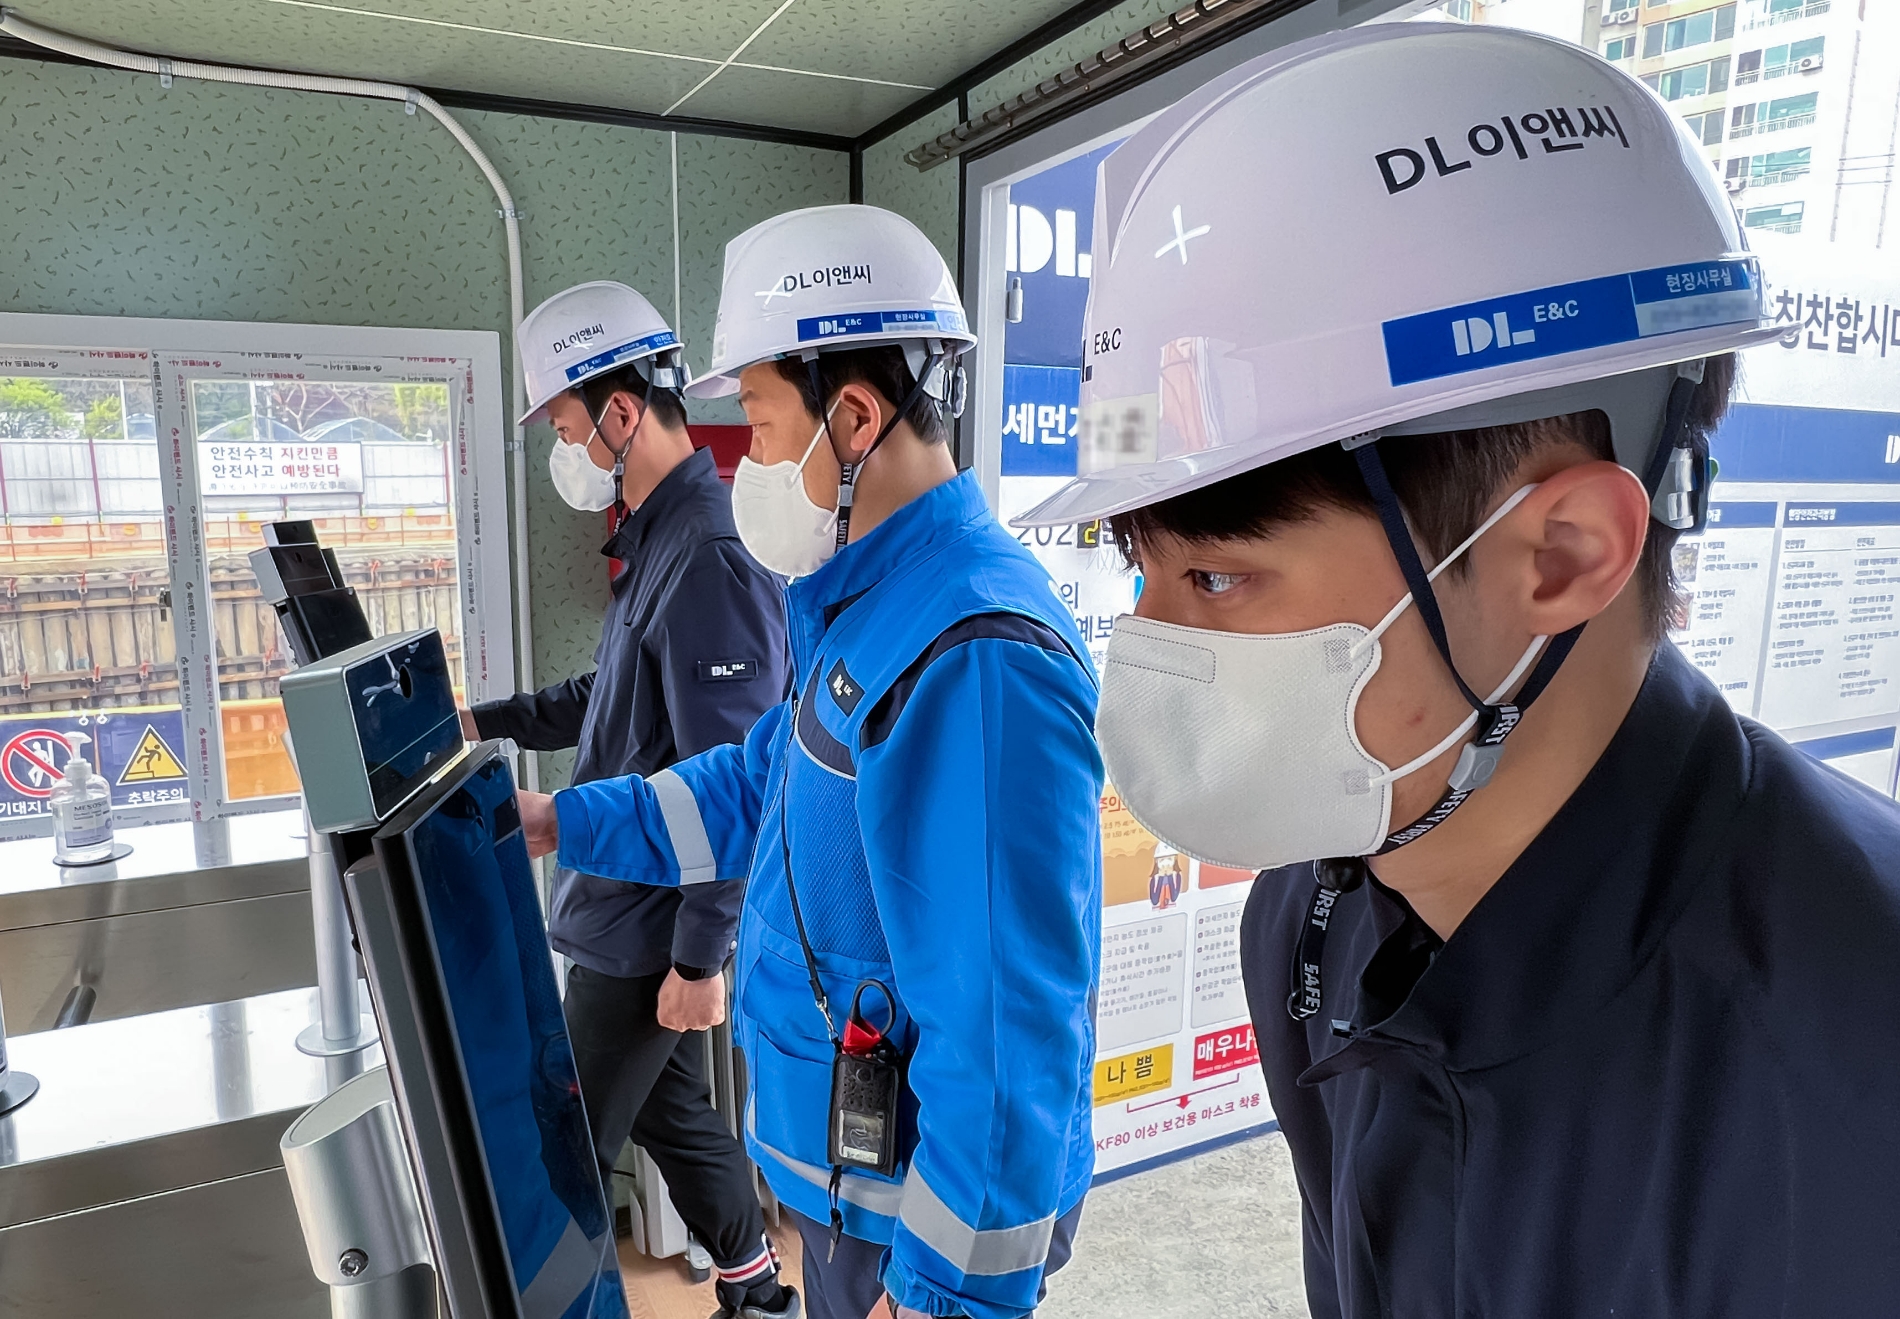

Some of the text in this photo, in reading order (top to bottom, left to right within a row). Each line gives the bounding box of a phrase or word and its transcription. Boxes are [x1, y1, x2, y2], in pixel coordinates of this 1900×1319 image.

[1375, 105, 1630, 195] DL이앤씨
[783, 264, 872, 292] DL이앤씨
[1665, 267, 1732, 293] 현장사무실
[552, 323, 605, 354] DL이앤씨
[818, 318, 862, 335] DL E&C
[1452, 300, 1579, 356] DL E&C
[1094, 328, 1122, 356] E&C
[210, 446, 273, 461] 안전수칙
[212, 464, 341, 479] 안전사고 예방된다
[711, 665, 733, 677] DL
[1485, 705, 1520, 744] IRST
[128, 787, 183, 805] 추락주의
[1098, 796, 1127, 814] 주의
[1311, 888, 1342, 931] IRST
[1197, 1028, 1258, 1062] 매우나
[1096, 1093, 1260, 1152] KF80 이상 보건용 마스크 착용
